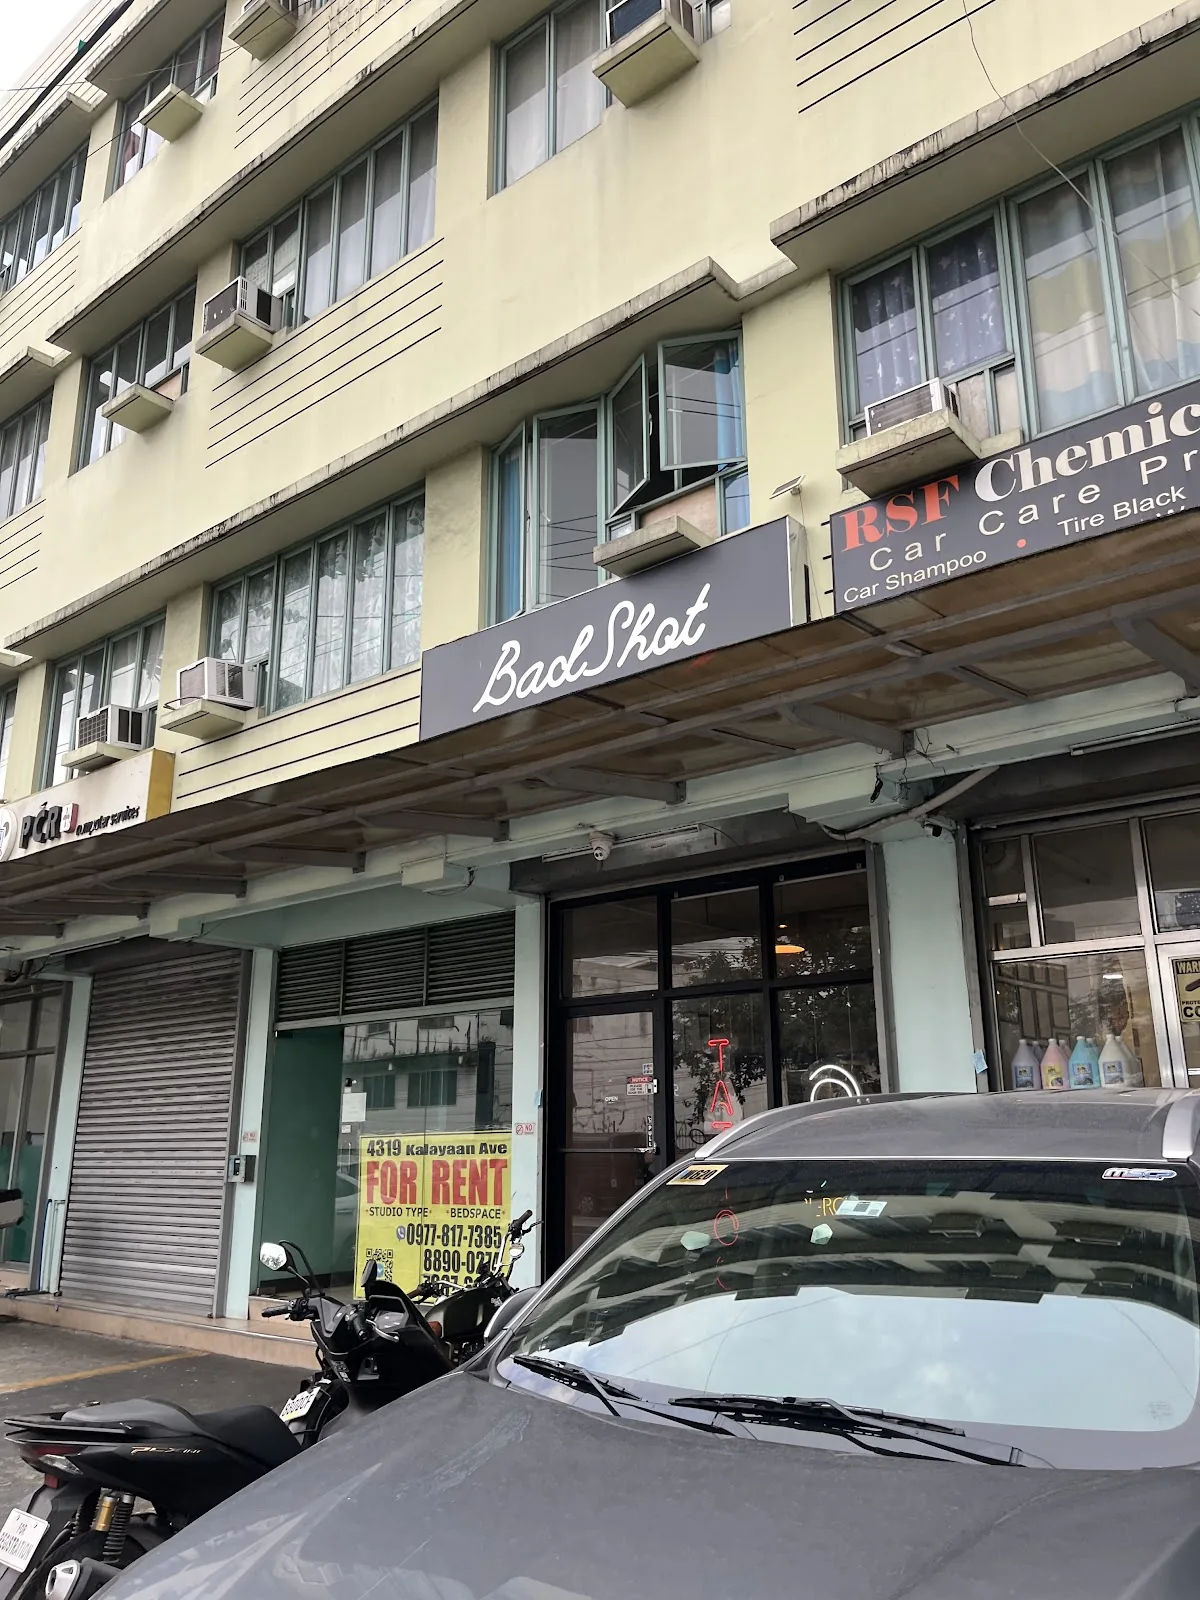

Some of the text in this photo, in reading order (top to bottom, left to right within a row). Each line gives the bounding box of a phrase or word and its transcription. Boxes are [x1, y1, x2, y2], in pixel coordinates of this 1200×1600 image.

[840, 402, 1200, 551] RSF Chemic
[843, 583, 880, 603] Car
[885, 550, 987, 590] Shampoo
[1057, 513, 1105, 536] Tire
[1113, 485, 1187, 520] Black
[869, 532, 946, 571] Car
[979, 484, 1100, 535] Care
[1177, 961, 1200, 974] WAR
[367, 1139, 508, 1157] 4319 Kalayaan Ave
[366, 1158, 508, 1206] FOR RENT
[369, 1207, 501, 1220] STUDIO TYPE BEDSPACE
[406, 1222, 501, 1249] 0977-817-7385
